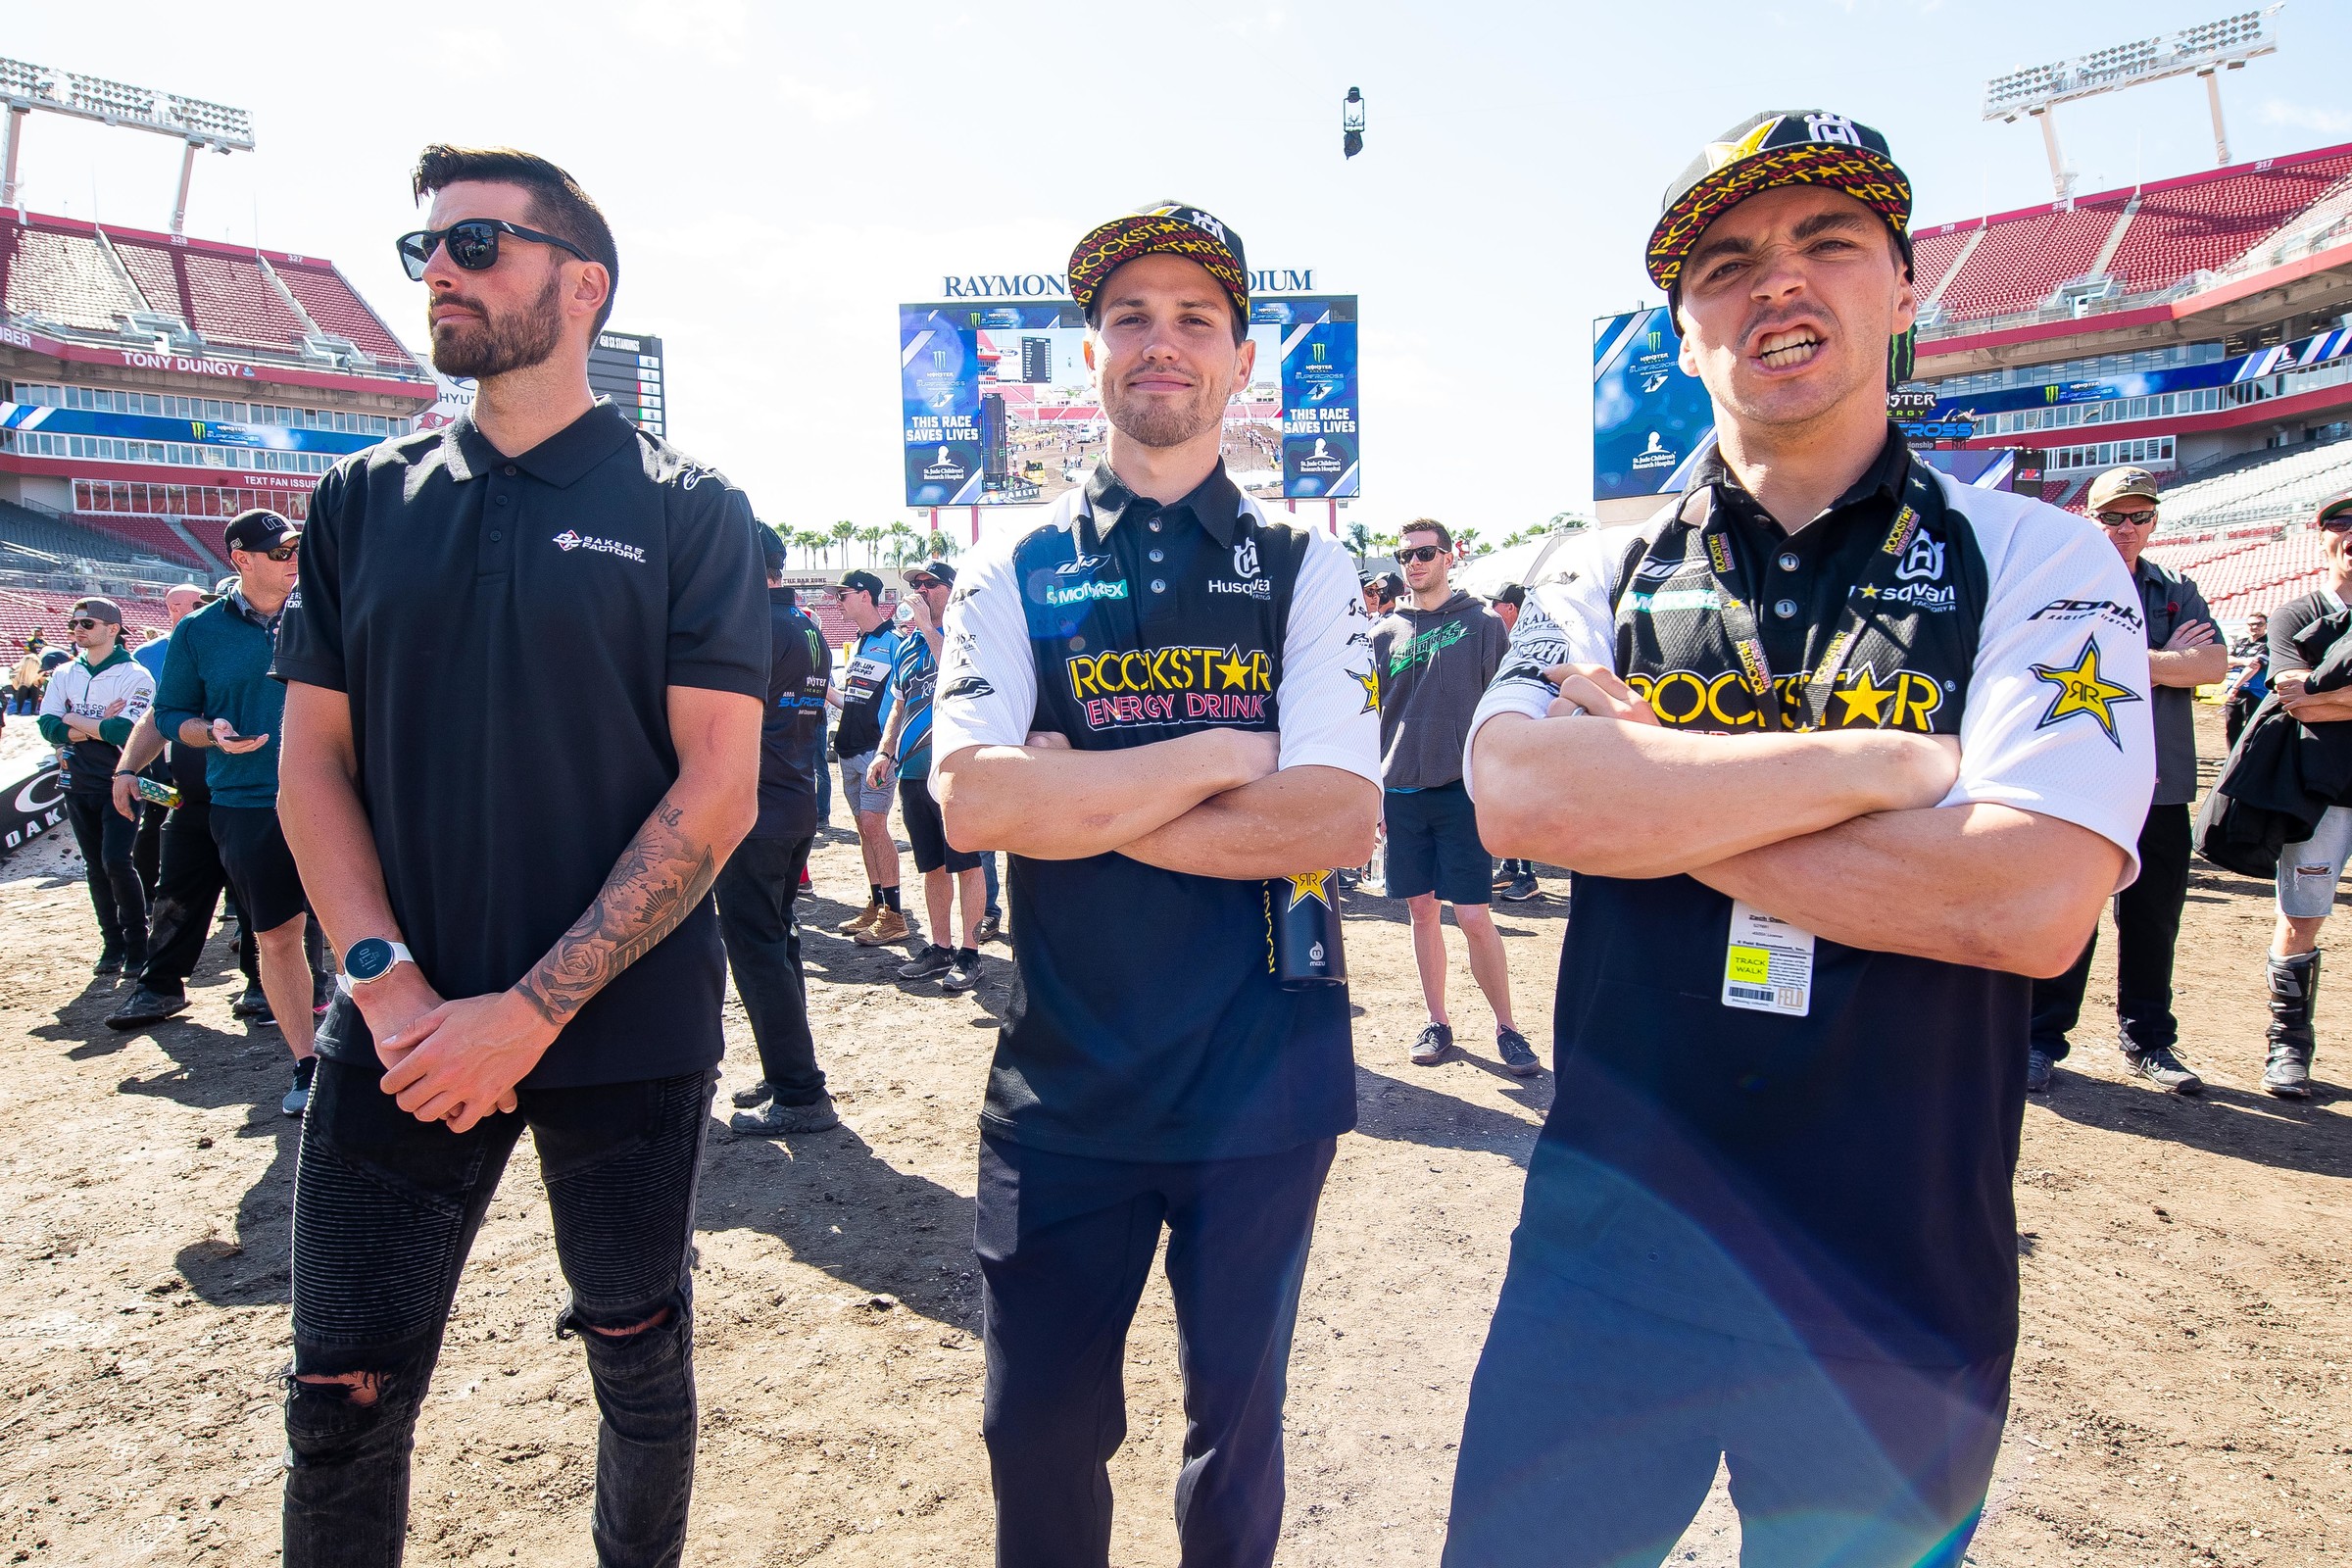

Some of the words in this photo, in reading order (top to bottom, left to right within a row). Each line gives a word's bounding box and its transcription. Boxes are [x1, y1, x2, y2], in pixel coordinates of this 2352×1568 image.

[2255, 159, 2275, 170] 317
[2052, 200, 2068, 210] 318
[1940, 222, 1956, 232] 319
[171, 233, 187, 245] 328
[287, 253, 303, 264] 327
[944, 274, 1070, 297] RAYMON
[122, 351, 172, 368] TONY
[176, 357, 239, 376] DUNGY
[439, 393, 475, 405] HYU
[1290, 409, 1317, 420] THIS
[1319, 408, 1349, 420] RACE
[911, 416, 939, 428] THIS
[942, 416, 972, 427] RACE
[1284, 421, 1321, 434] SAVES
[1323, 420, 1356, 433] LIVES
[906, 429, 945, 441] SAVES
[946, 428, 979, 441] LIVES
[244, 475, 268, 485] TEXT
[270, 477, 288, 486] FAN
[582, 542, 641, 562] FACTORY
[1069, 649, 1272, 699] ROCKSTAR
[1089, 694, 1175, 725] ENERGY
[1187, 692, 1265, 718] DRINK
[1735, 956, 1766, 966] TRACK
[1736, 965, 1763, 975] WALK
